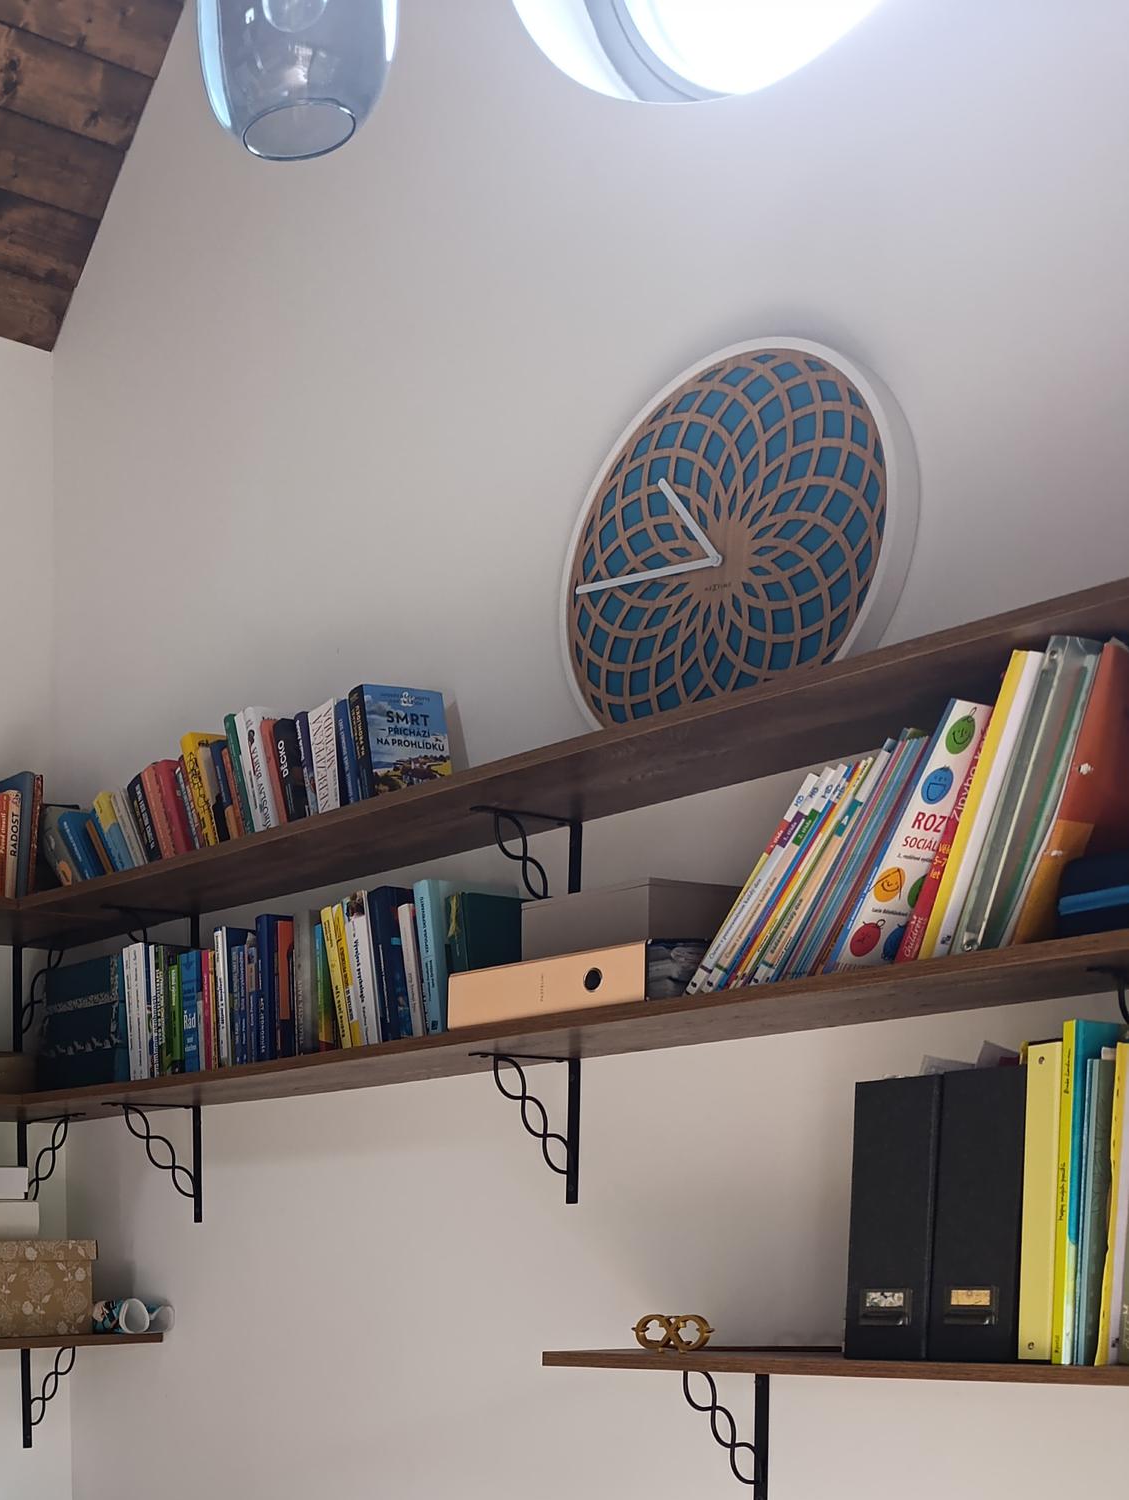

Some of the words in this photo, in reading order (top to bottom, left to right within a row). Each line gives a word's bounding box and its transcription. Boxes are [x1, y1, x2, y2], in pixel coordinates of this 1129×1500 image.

[386, 710, 430, 727] SMRT
[321, 708, 336, 769] METODA
[388, 725, 431, 738] PŘICHÁZÍ
[391, 739, 445, 752] PROHLÍDKU
[309, 715, 331, 812] NEBEZPEČNÁ
[9, 811, 19, 856] RADOST
[930, 868, 940, 879] let
[356, 967, 365, 1003] psychologie
[183, 1010, 196, 1029] Řád
